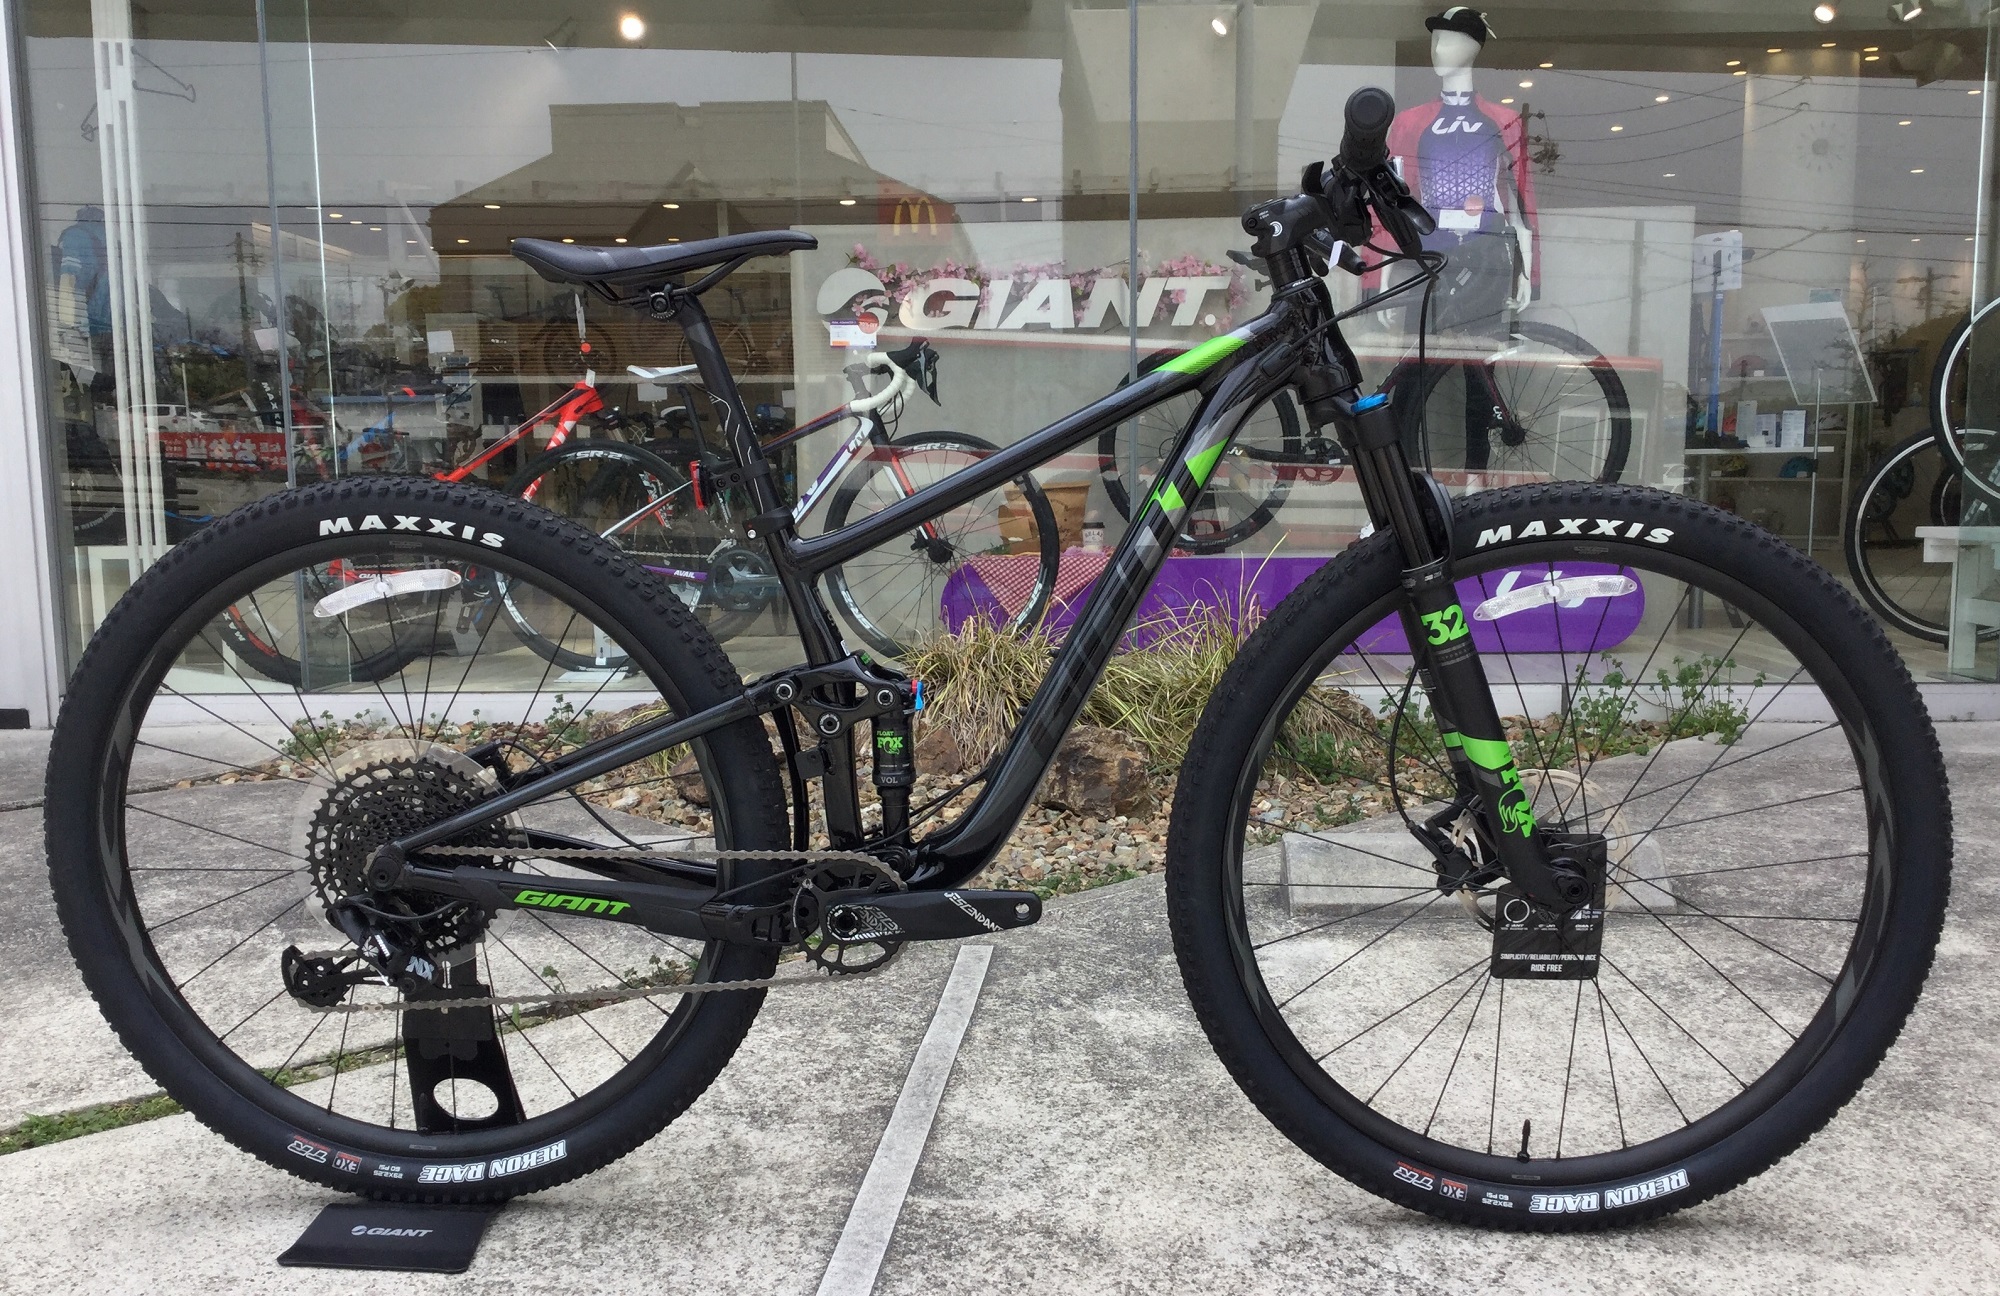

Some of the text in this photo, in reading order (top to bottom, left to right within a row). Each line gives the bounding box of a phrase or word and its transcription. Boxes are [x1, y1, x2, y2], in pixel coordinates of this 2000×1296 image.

[1432, 116, 1483, 134] Liv
[576, 450, 622, 460] SR-2
[913, 442, 960, 452] SR-2
[319, 514, 505, 548] MAXXIS
[1475, 518, 1674, 548] MAXXIS
[674, 570, 696, 578] AVAIL
[1421, 604, 1469, 645] 32
[876, 736, 904, 754] FOX
[514, 890, 631, 915] GIANT
[1531, 964, 1563, 972] RIDE FREE
[287, 1140, 327, 1163] TR
[334, 1155, 358, 1173] EXO
[417, 1139, 567, 1184] REKON RACE
[1393, 1166, 1434, 1191] TR
[1440, 1182, 1465, 1201] EXO
[1529, 1168, 1690, 1213] REKON RACE
[366, 1227, 434, 1238] GIANT
